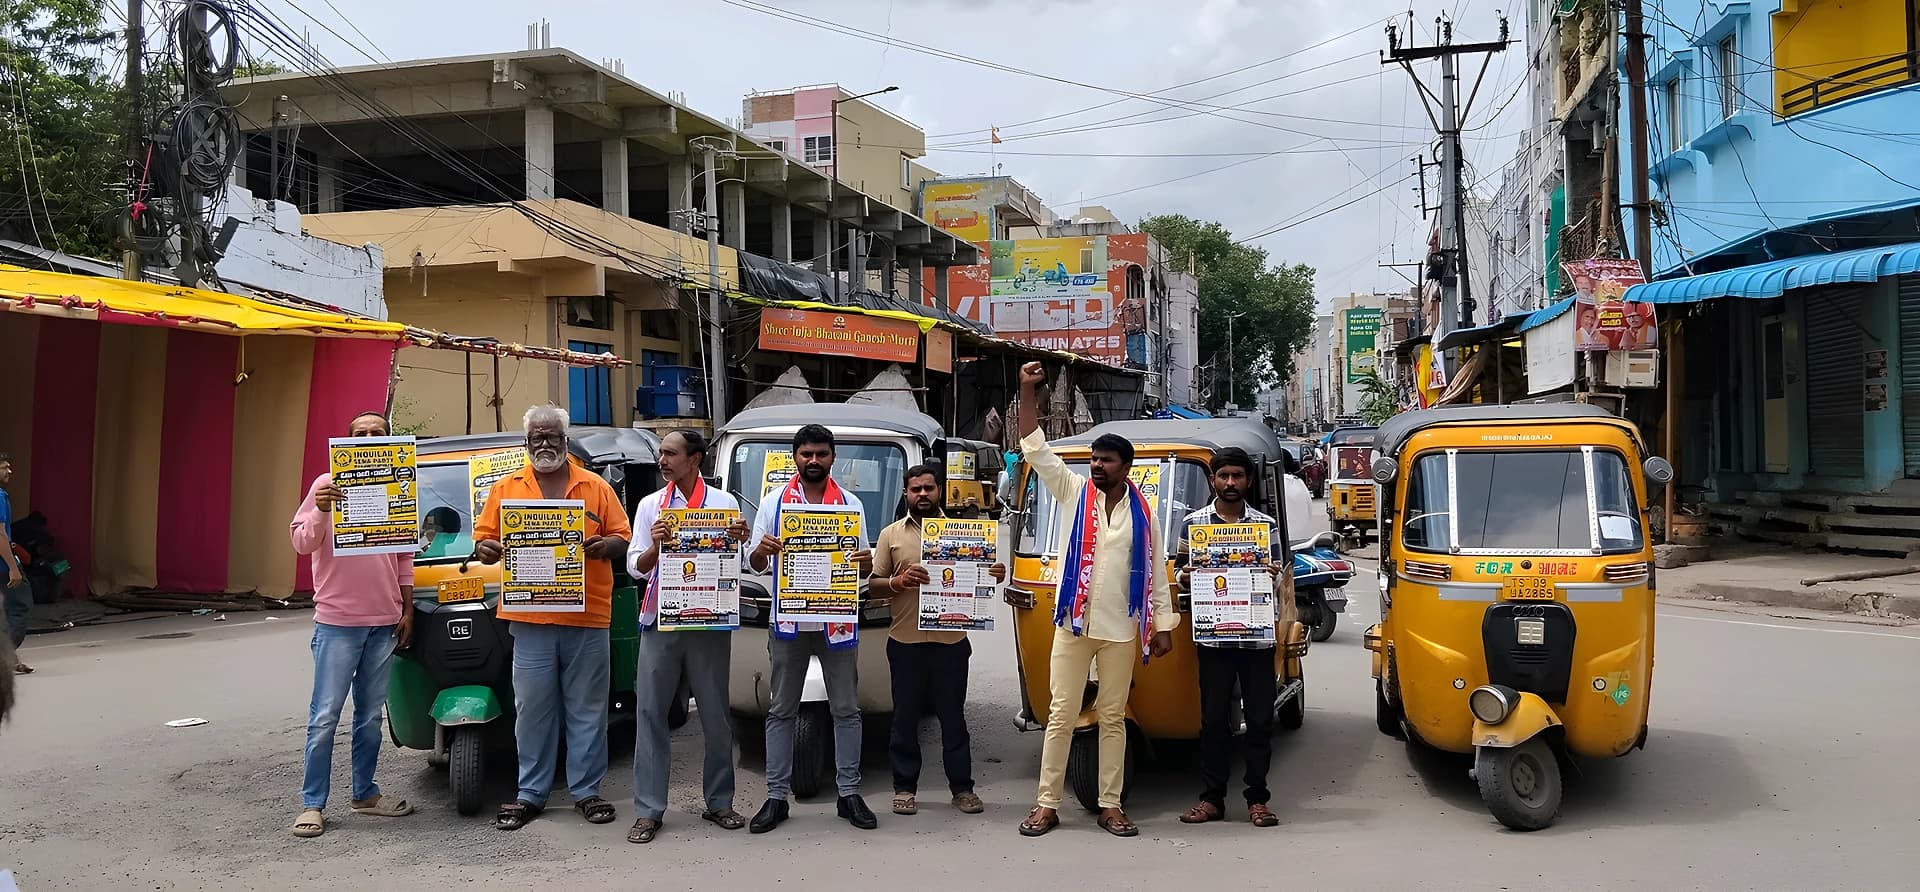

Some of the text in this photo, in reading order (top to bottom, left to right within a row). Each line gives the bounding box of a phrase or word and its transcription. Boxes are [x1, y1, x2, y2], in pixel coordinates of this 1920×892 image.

[764, 323, 788, 336] Shree
[815, 326, 852, 341] Bhavani
[853, 330, 886, 344] Ganesh
[353, 450, 393, 459] INQUILAB
[524, 513, 562, 521] INQUILAB
[684, 512, 725, 520] INQUILAB
[802, 517, 840, 526] INQUILAB
[944, 522, 983, 530] INQUILAB
[1213, 527, 1253, 535] INQUILAB
[1475, 562, 1577, 575] FOR HIRE
